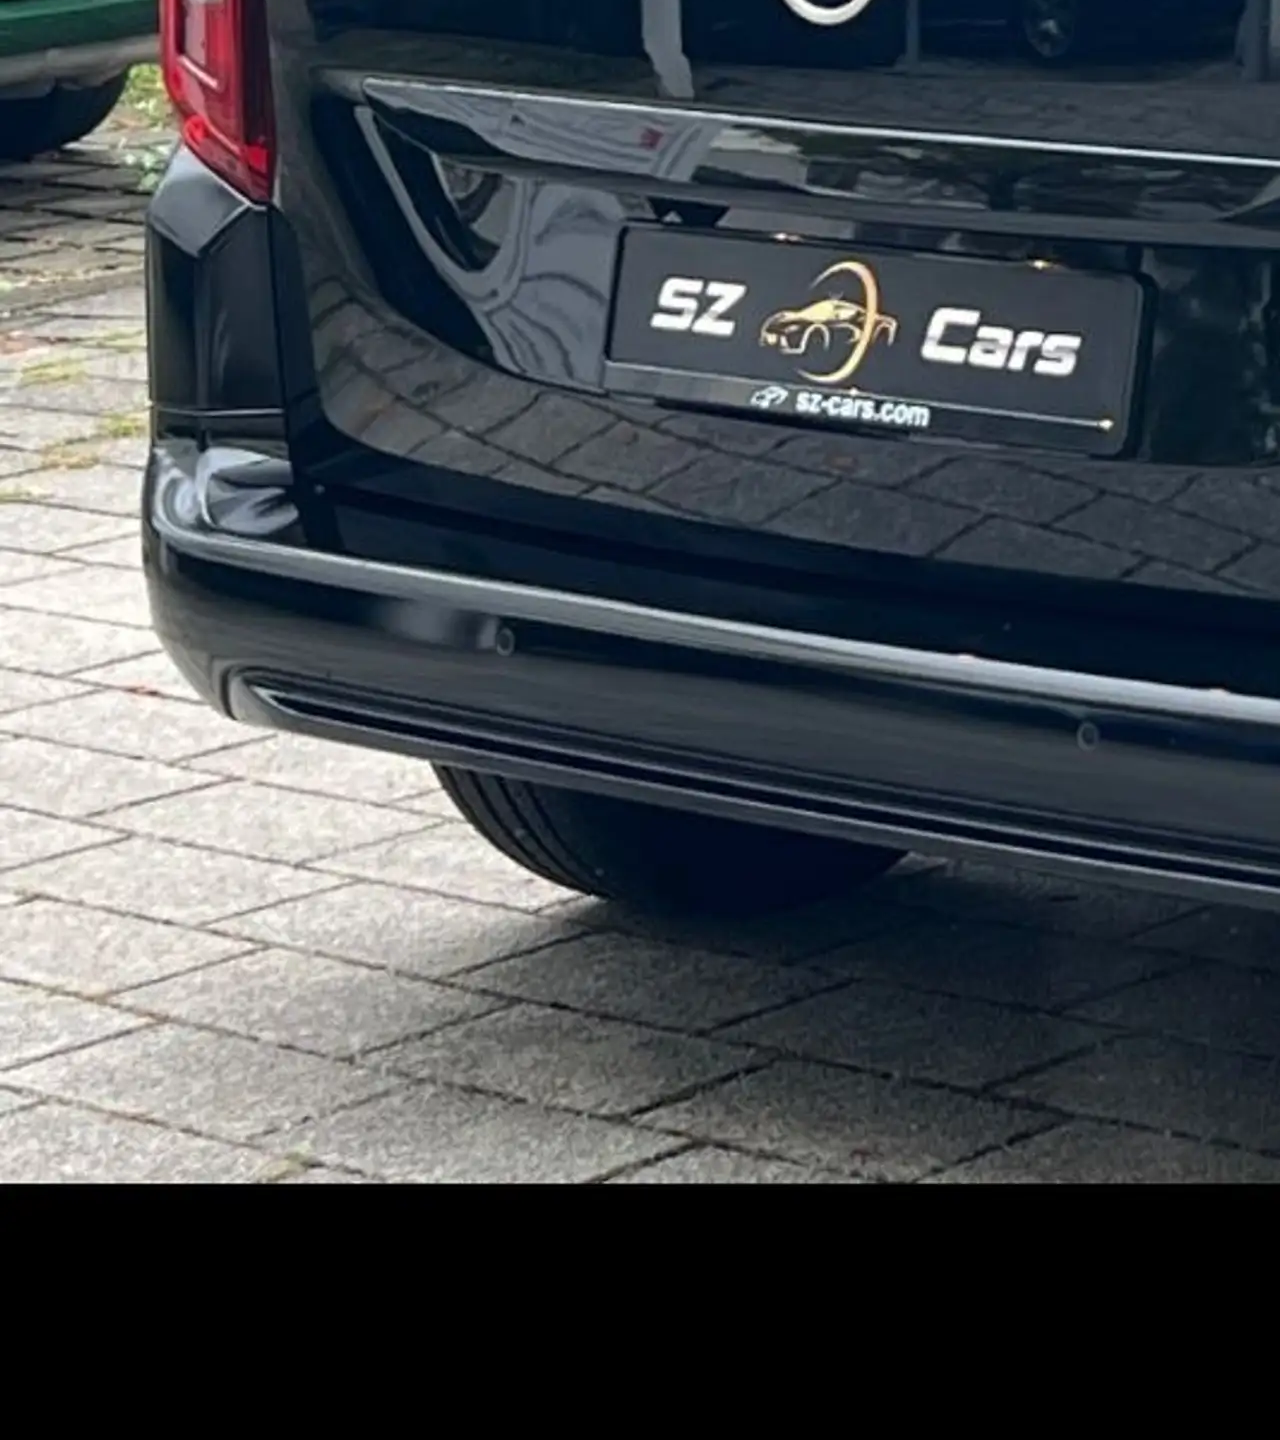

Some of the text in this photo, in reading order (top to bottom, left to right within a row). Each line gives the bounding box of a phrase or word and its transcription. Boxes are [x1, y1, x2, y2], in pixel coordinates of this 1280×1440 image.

[650, 275, 1082, 378] SZ Cars
[794, 389, 931, 428] sz-cars.com
